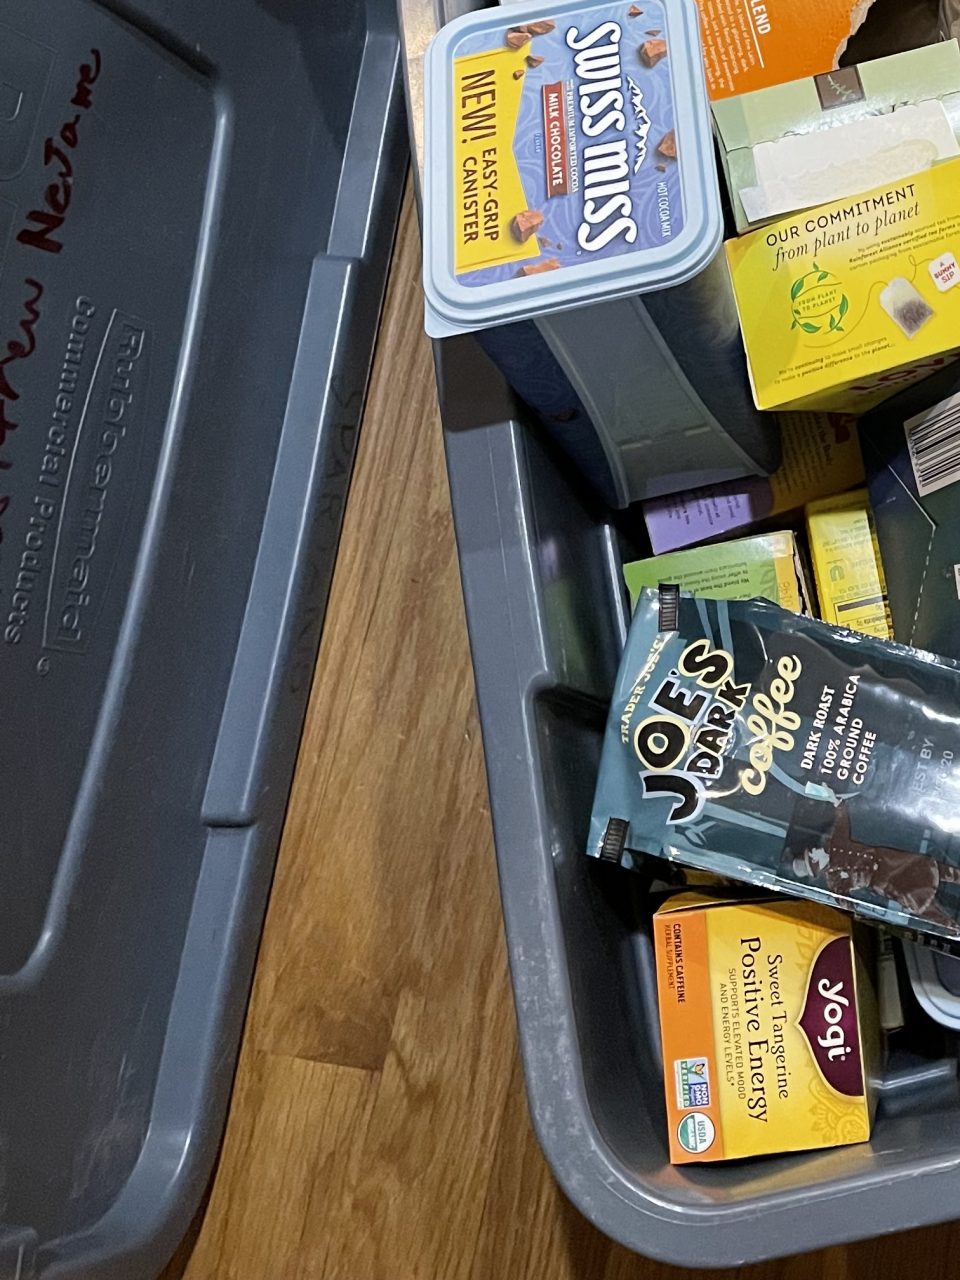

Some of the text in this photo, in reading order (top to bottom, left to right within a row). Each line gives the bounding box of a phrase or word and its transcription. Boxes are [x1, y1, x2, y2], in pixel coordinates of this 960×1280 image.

[461, 69, 498, 145] NEW!
[565, 21, 627, 137] SWISS
[547, 93, 563, 186] MILK CHOCOLATE
[567, 91, 578, 192] PREMIUM IMPORTED COCOA
[462, 156, 479, 246] CANISTER
[482, 147, 499, 242] EASY-GRIP
[657, 181, 672, 237] HOT COCOA MIX
[766, 184, 916, 246] OUR COMMITMENT
[775, 202, 920, 270] from plant to planet
[46, 293, 96, 498] Commercial
[57, 320, 146, 646] Rubbermaid
[4, 503, 50, 646] Products
[621, 685, 645, 744] TRADER
[634, 638, 734, 825] JOE'S
[684, 676, 751, 779] DARK
[741, 655, 801, 795] coffee
[801, 685, 835, 770] DARK ROAST
[821, 674, 861, 774] 100% ARABICA
[837, 718, 863, 780] GROUND
[853, 730, 877, 785] COFFEE
[673, 923, 685, 1003] CONTAINS CAFFEINE
[720, 983, 728, 1001] AND
[721, 1005, 731, 1042] ENERGY
[728, 968, 746, 1099] SUPPORTS ELEVATED MOOD
[740, 936, 769, 1123] Positive Energy
[767, 954, 791, 1099] Sweet Tangerine
[817, 978, 851, 1061] yogi
[693, 1084, 702, 1106] GMO
[697, 1120, 707, 1145] USDA
[700, 1083, 709, 1105] NON
